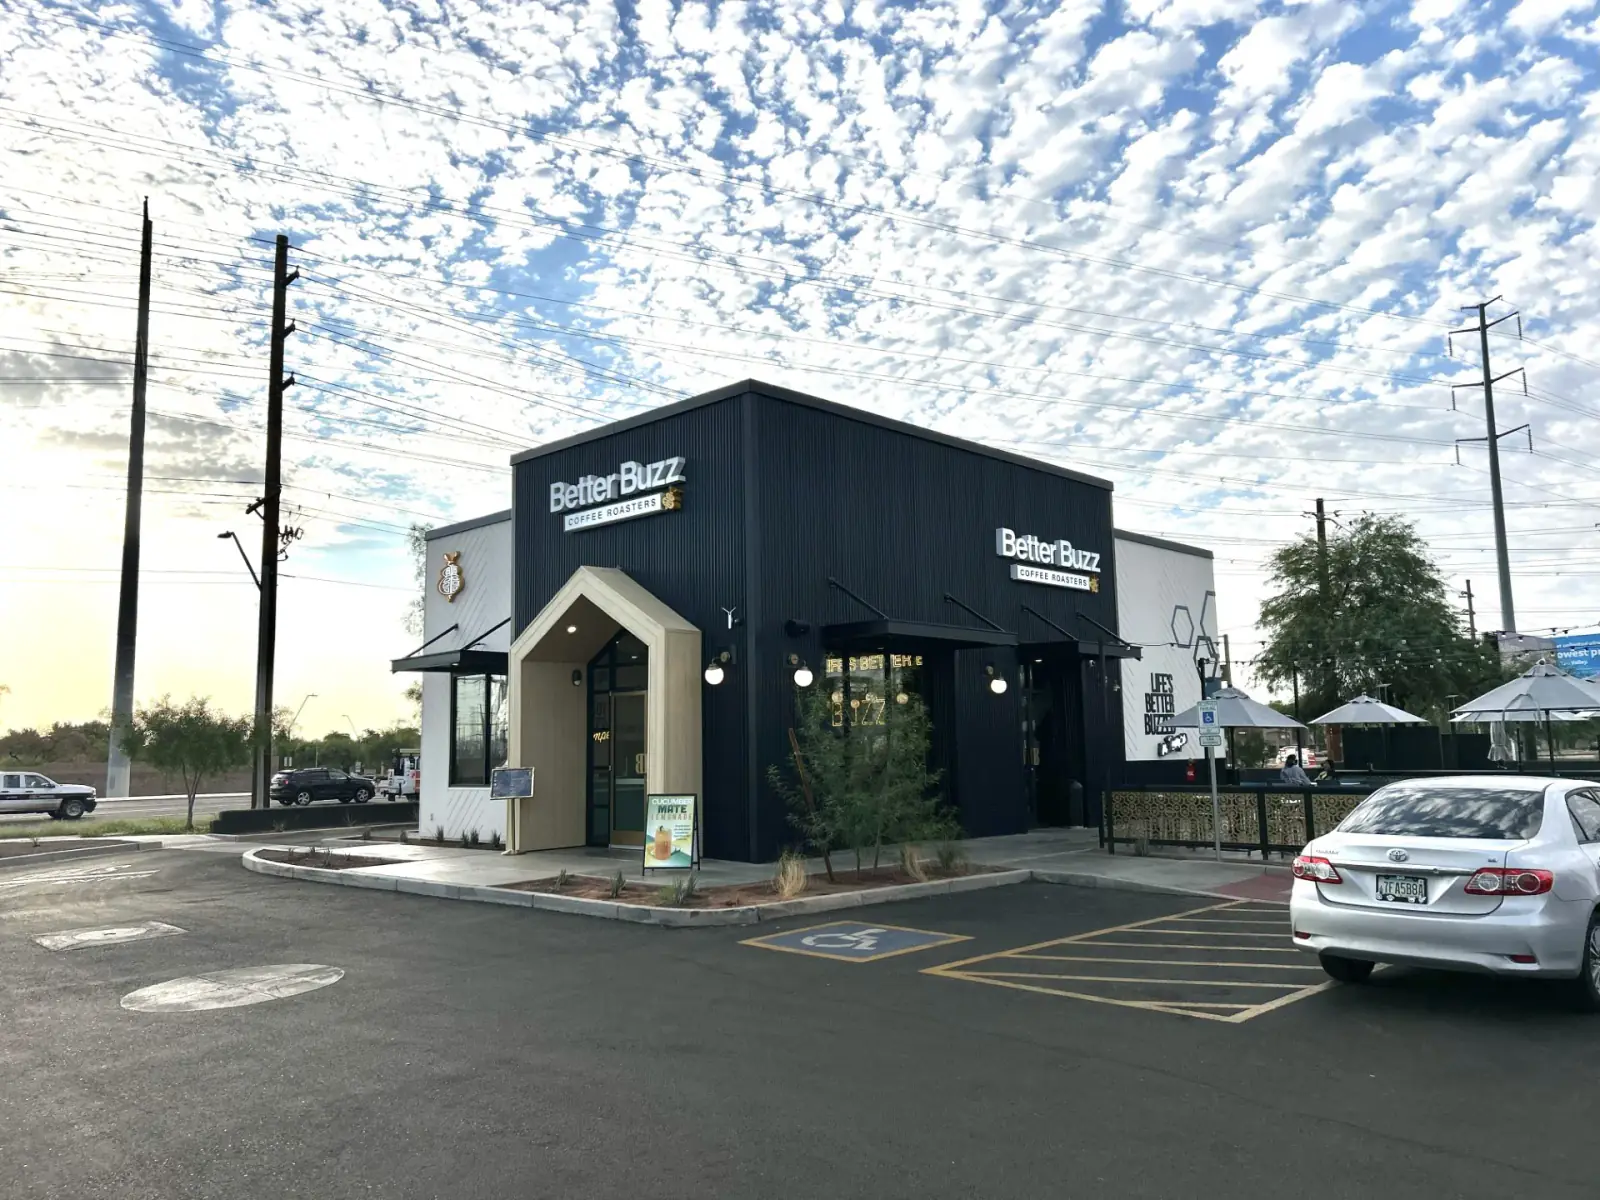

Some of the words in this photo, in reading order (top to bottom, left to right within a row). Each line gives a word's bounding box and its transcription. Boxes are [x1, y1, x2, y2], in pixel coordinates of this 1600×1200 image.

[550, 474, 620, 513] Better
[620, 456, 685, 495] Buzz
[568, 511, 603, 526] COFFEE
[606, 498, 657, 516] ROASTERS
[997, 527, 1056, 564] Better
[1056, 539, 1101, 572] Buzz
[1019, 568, 1049, 580] COFFEE
[1051, 573, 1087, 587] ROASTERS
[1557, 648, 1589, 659] owest
[1144, 692, 1175, 713] BETTER
[657, 804, 687, 814] MATE
